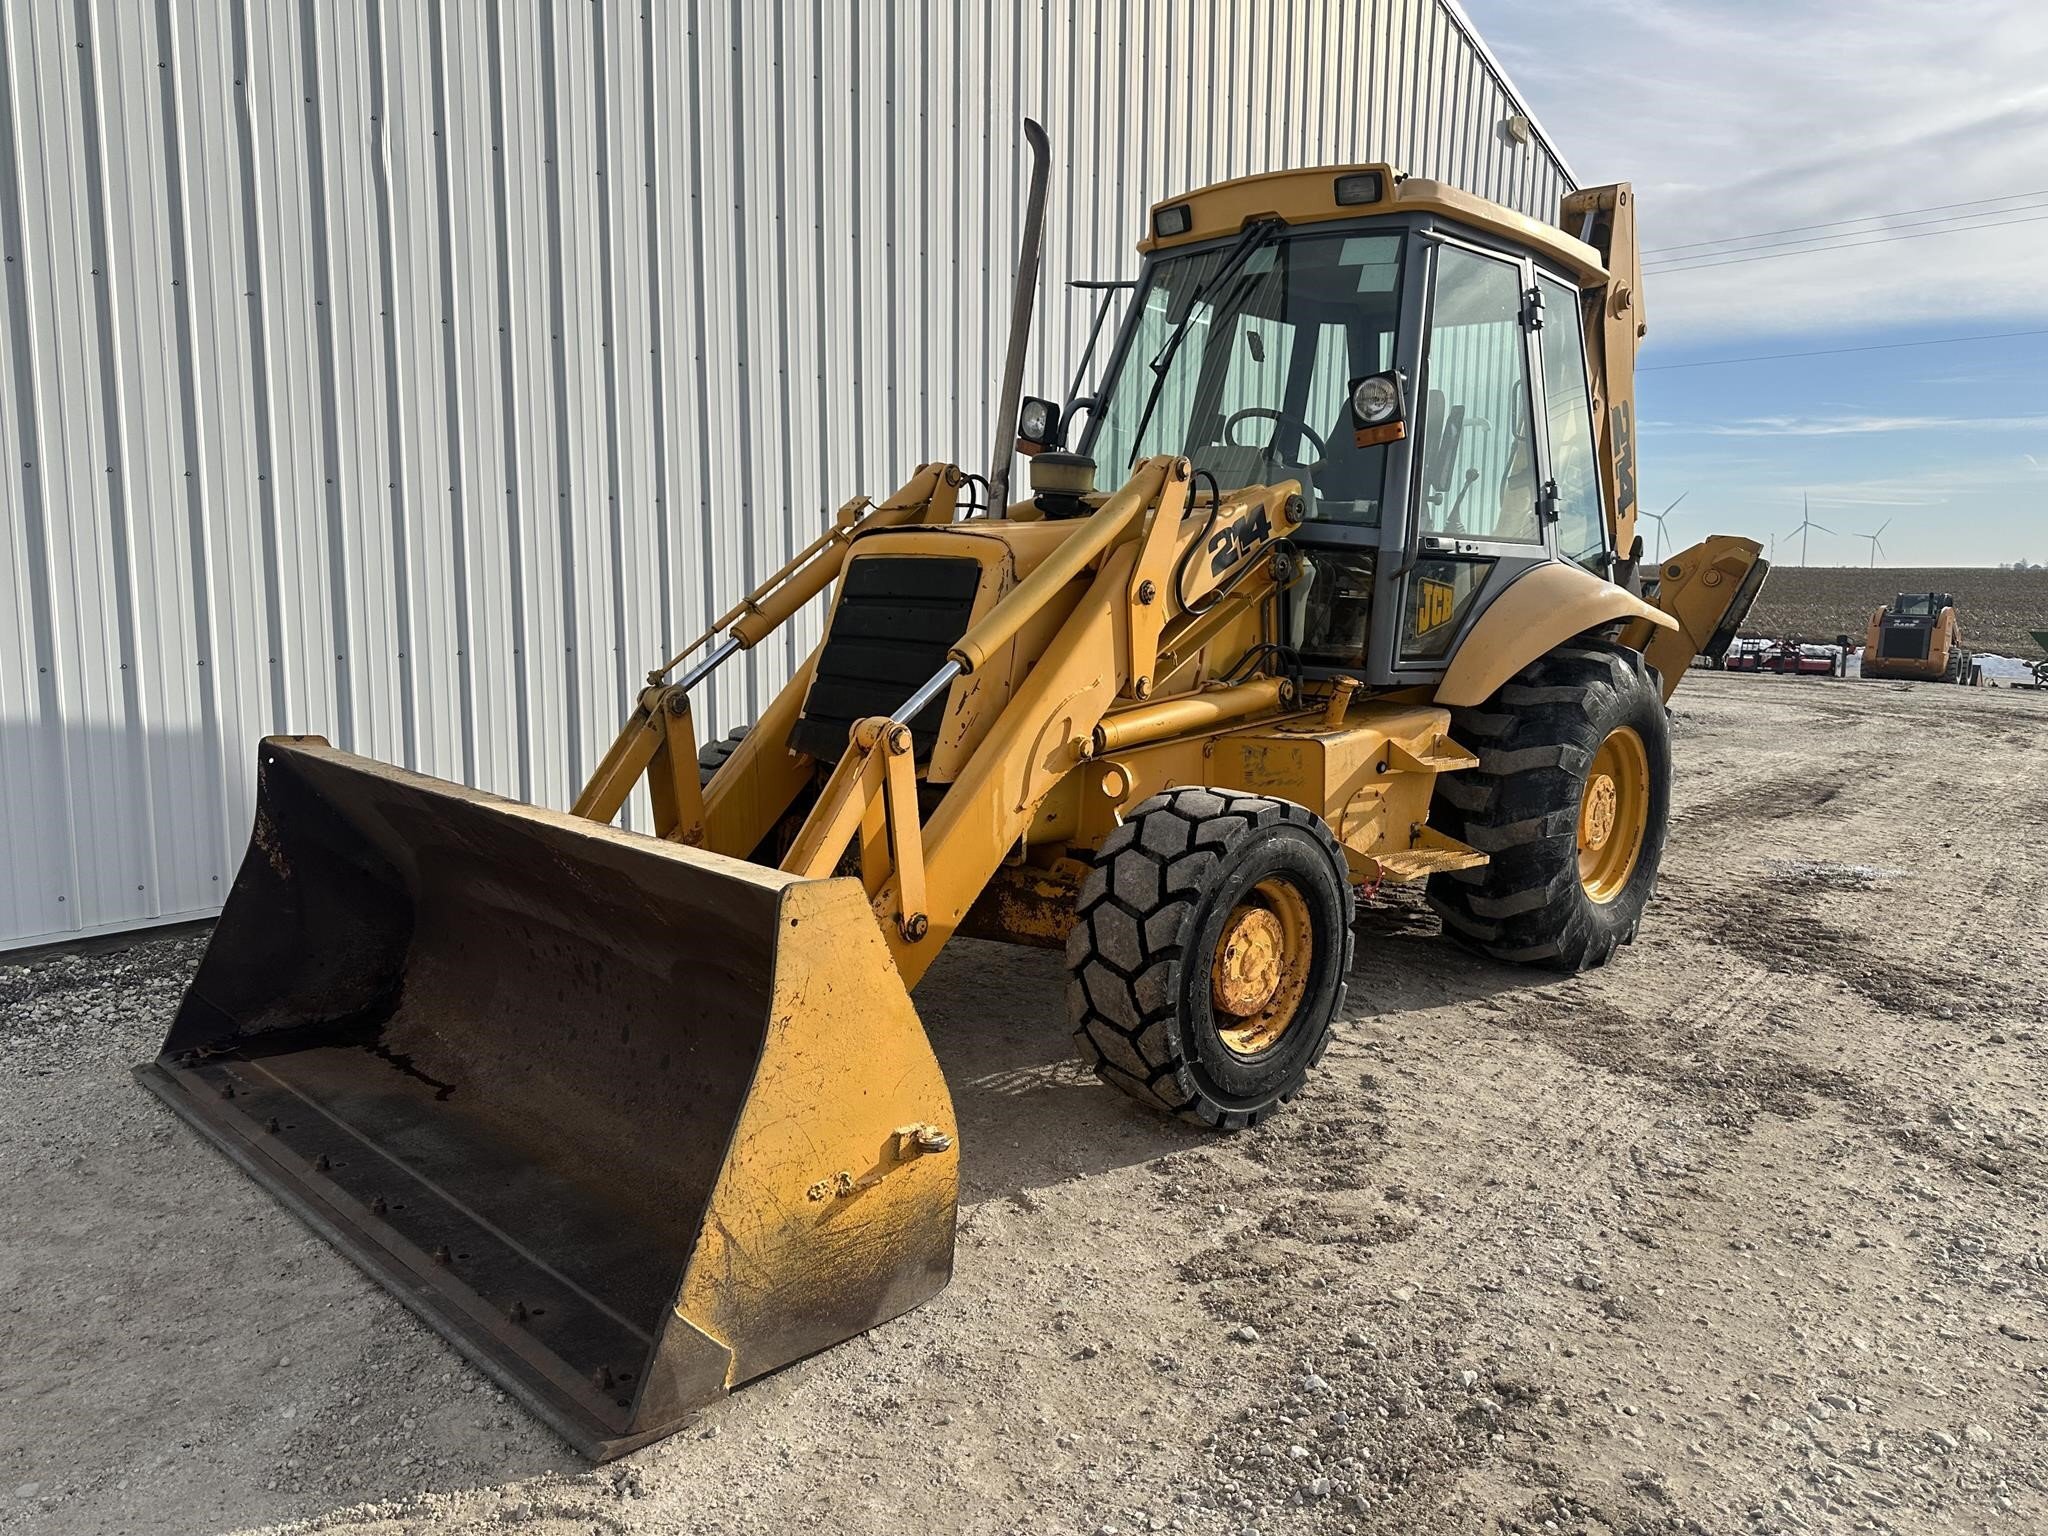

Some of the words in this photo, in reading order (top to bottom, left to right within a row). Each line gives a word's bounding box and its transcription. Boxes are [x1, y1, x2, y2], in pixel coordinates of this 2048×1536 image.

[1611, 400, 1634, 519] 214
[1207, 502, 1272, 578] 214
[1418, 581, 1453, 635] JCB
